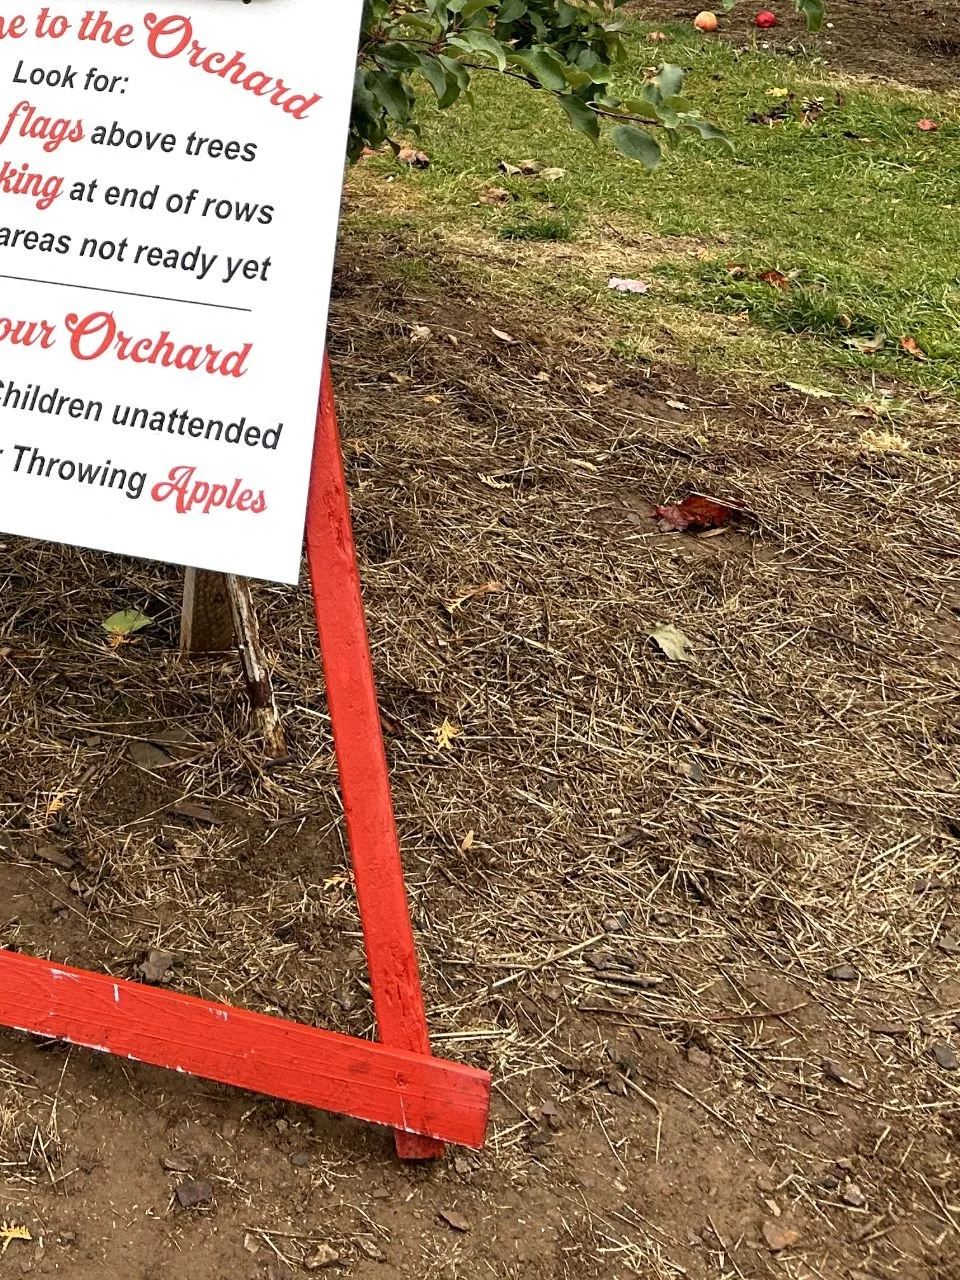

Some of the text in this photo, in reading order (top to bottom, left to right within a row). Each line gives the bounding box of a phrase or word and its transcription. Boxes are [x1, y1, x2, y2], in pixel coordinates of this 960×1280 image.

[12, 60, 130, 94] Look for:
[35, 8, 72, 38] to
[77, 11, 135, 47] the
[143, 12, 323, 120] Orchard
[90, 121, 177, 153] above
[185, 131, 258, 162] trees
[69, 178, 98, 203] at
[104, 184, 160, 210] end
[166, 189, 199, 214] of
[201, 197, 275, 225] rows
[79, 237, 128, 263] not
[133, 245, 218, 280] ready
[221, 255, 272, 284] yet
[64, 310, 254, 378] Orchard
[111, 404, 283, 450] unattended
[11, 444, 147, 500] Throwing
[150, 465, 268, 514] Apples
